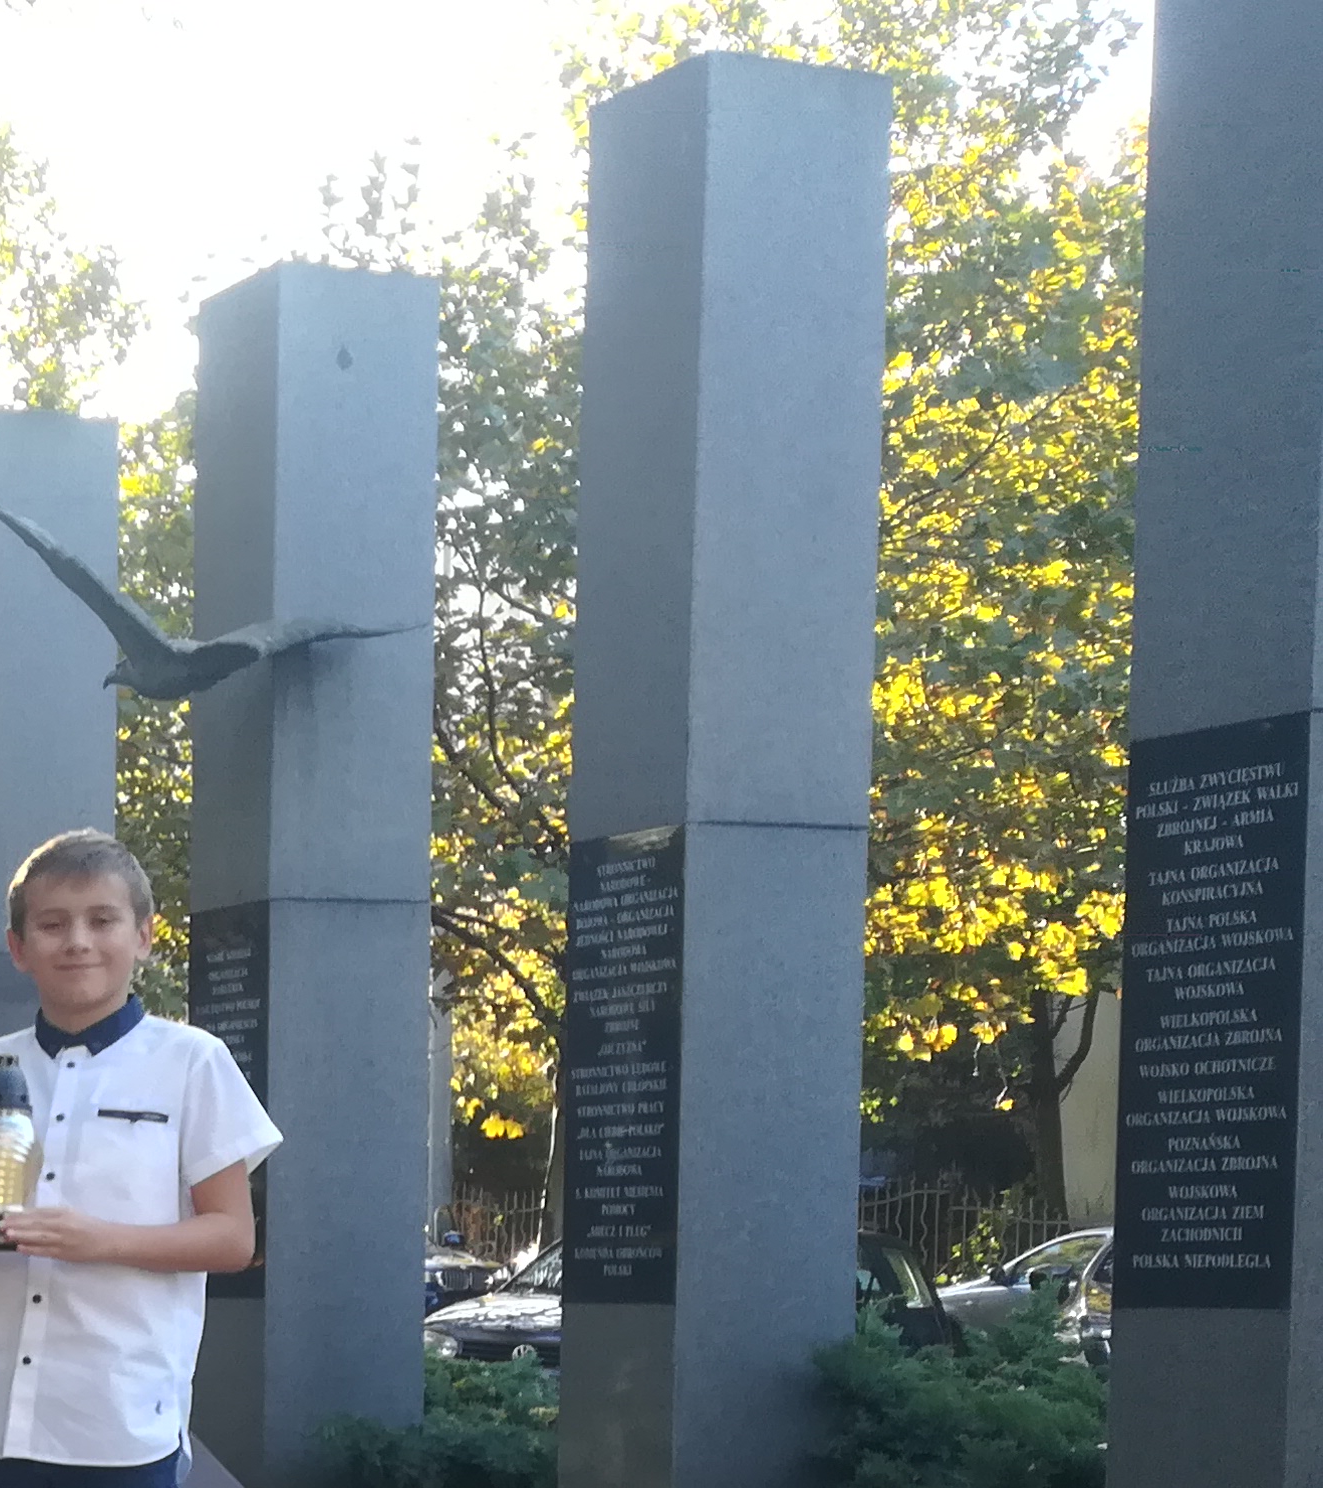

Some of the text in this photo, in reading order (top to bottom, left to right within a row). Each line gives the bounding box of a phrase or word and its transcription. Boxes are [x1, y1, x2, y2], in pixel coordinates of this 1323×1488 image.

[1136, 800, 1178, 819] POLSKI
[1257, 782, 1298, 800] WALKI
[1184, 834, 1244, 855] KRAJOWA
[1148, 857, 1280, 886] TAJNA ORGANIZACJA
[1162, 881, 1263, 906] KONSPIRACYJNA
[1166, 910, 1257, 933] TAJNA POLSKA
[1131, 927, 1294, 958] ORGANIZACJA WOJSKOWA
[1146, 957, 1276, 982] TAJNA ORGANIZACJA
[1174, 982, 1245, 1000] WOJSKOWA
[1160, 1009, 1258, 1029] WIELKOPOLSKA
[1135, 1028, 1282, 1052] ORGANIZACJA ZBROJNA
[1139, 1057, 1276, 1078] WOJSKO OCHOTNICZE
[1158, 1086, 1255, 1104] WIELKOPOLSKA
[1126, 1106, 1287, 1127] ORGANIZACJA WOJSKOWA
[1168, 1132, 1240, 1152] POZNAŃSKA
[1131, 1155, 1278, 1174] ORGANIZACJA ZBROJNA
[1142, 1205, 1265, 1221] ORGANIZACJA ZIEM
[1161, 1227, 1242, 1242] ZACHODNICH
[1133, 1254, 1180, 1269] POLSKA
